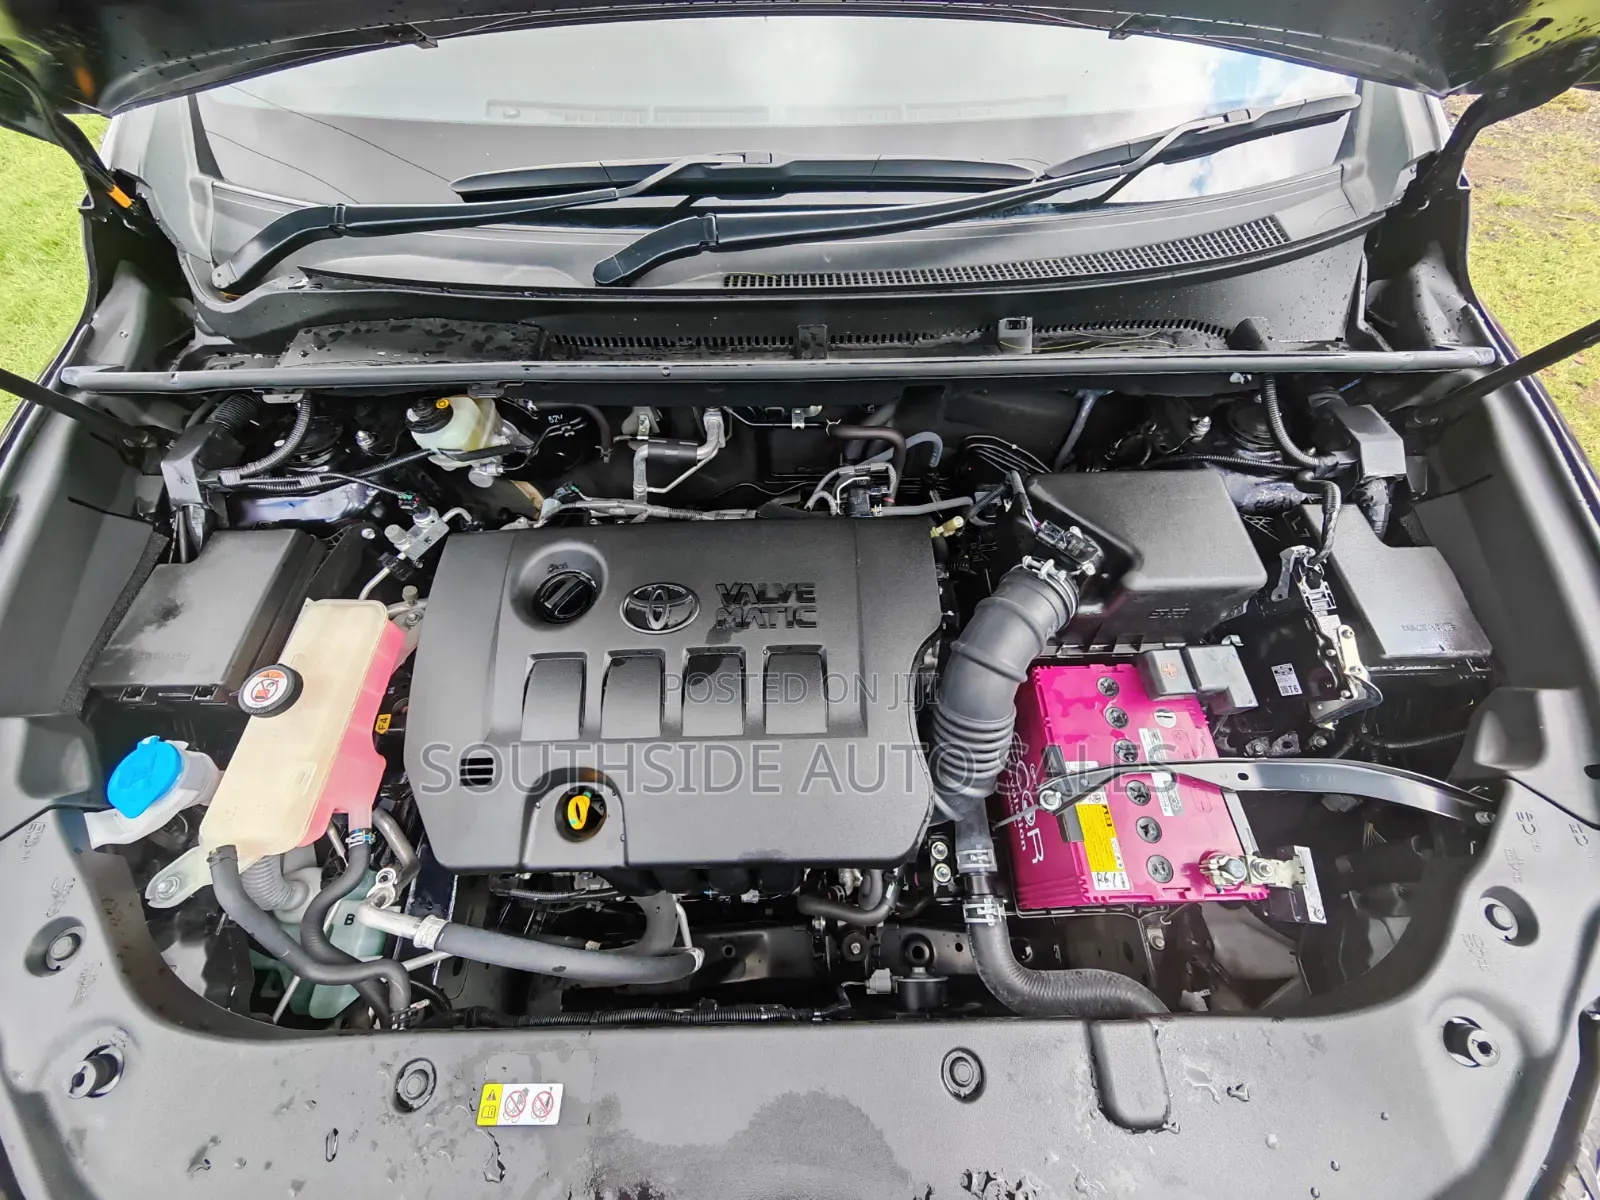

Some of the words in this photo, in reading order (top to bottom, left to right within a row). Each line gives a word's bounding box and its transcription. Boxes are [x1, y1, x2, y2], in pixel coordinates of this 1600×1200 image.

[715, 582, 816, 604] VALVE
[717, 605, 817, 629] MATIC
[344, 913, 355, 925] B
